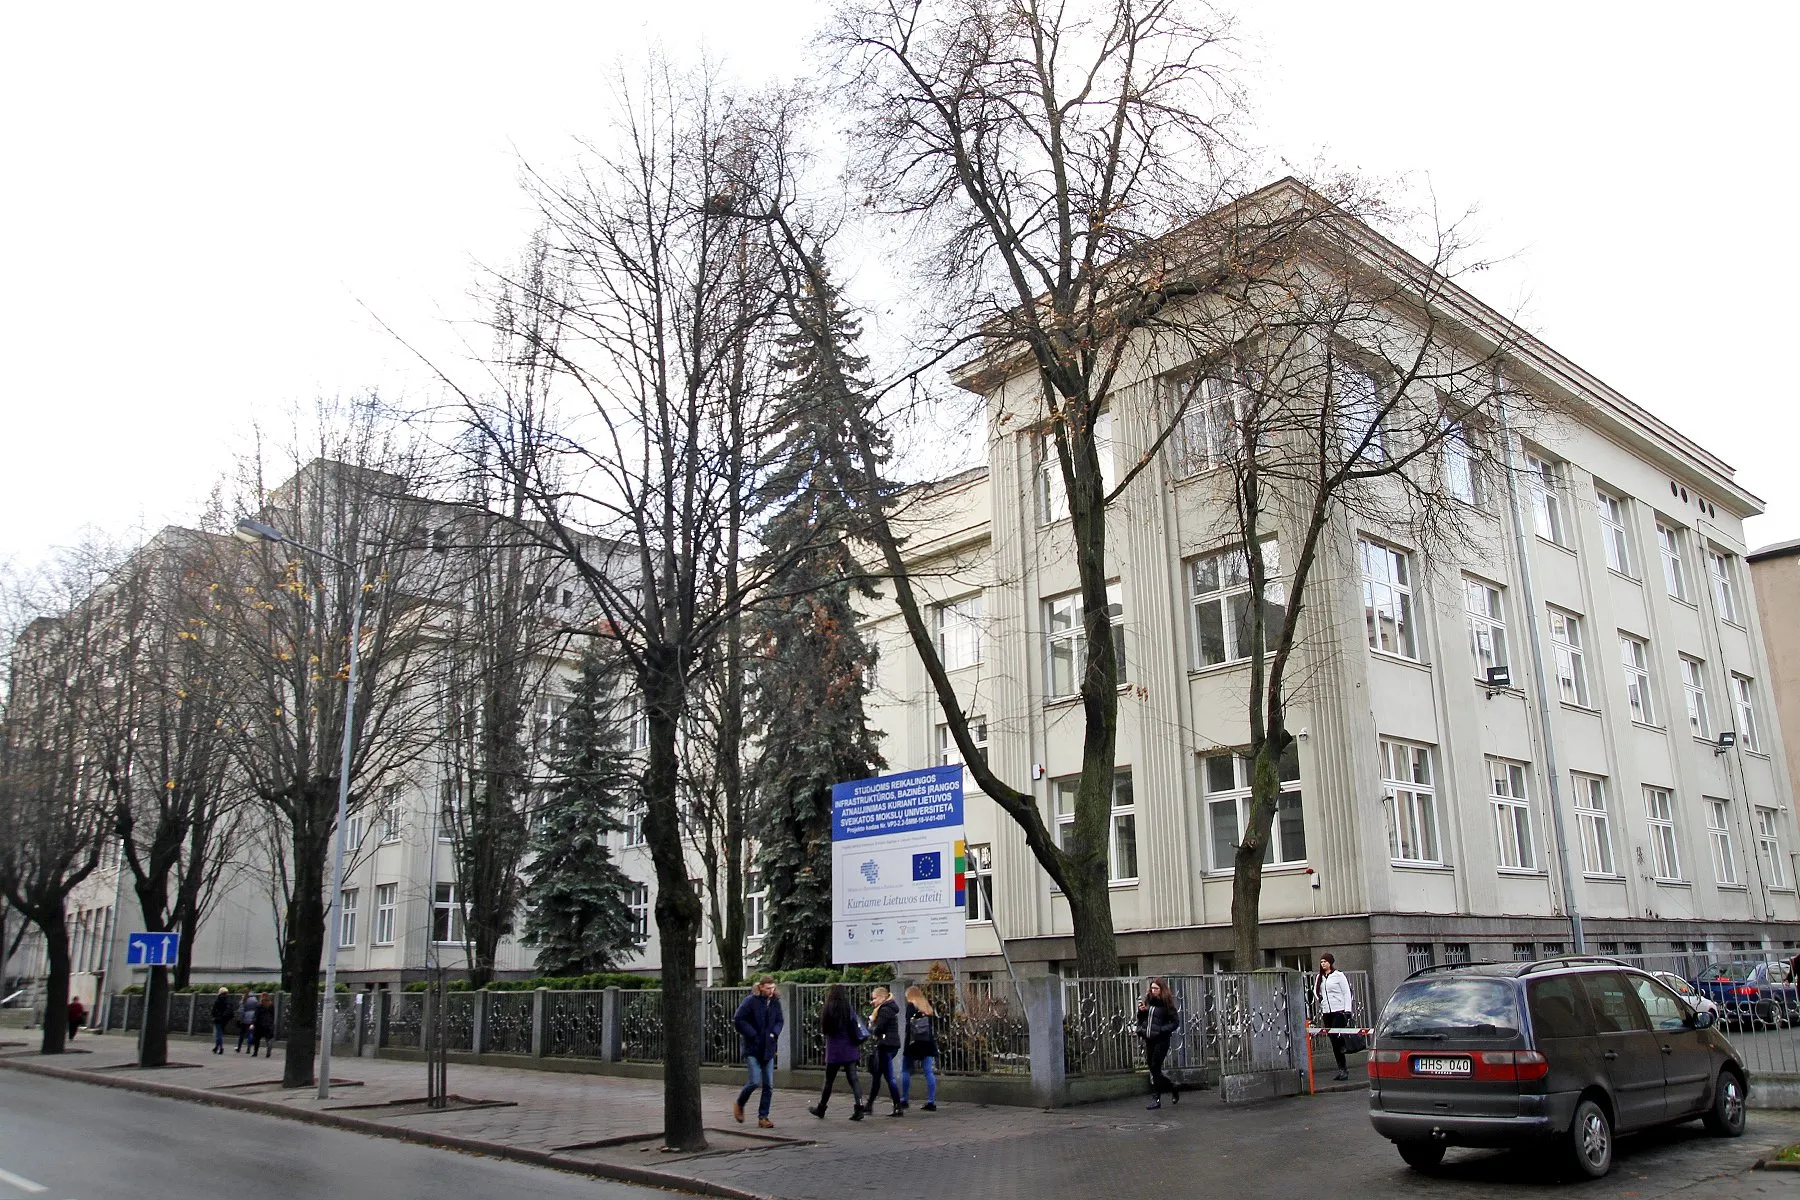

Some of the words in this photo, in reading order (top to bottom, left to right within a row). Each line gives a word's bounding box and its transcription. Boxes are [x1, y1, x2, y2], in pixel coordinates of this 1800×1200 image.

[855, 782, 890, 796] STUDIJOMS
[891, 774, 937, 790] REIKALINGOS
[898, 785, 927, 798] BAZINĖS
[928, 780, 960, 795] ĮRANGOS
[841, 814, 875, 827] SVEIKATOS
[876, 809, 904, 821] MOKSLŲ
[904, 802, 954, 817] UNIVERSITETĄ
[842, 803, 887, 817] ATNAUJINIMAS
[888, 797, 917, 809] KURIANT
[918, 792, 952, 806] LIETUVOS
[847, 896, 882, 910] Kuriame
[882, 895, 918, 907] Lietuvos
[918, 890, 943, 904] ateitį
[1420, 1059, 1443, 1071] HHS
[1449, 1060, 1469, 1071] 040
